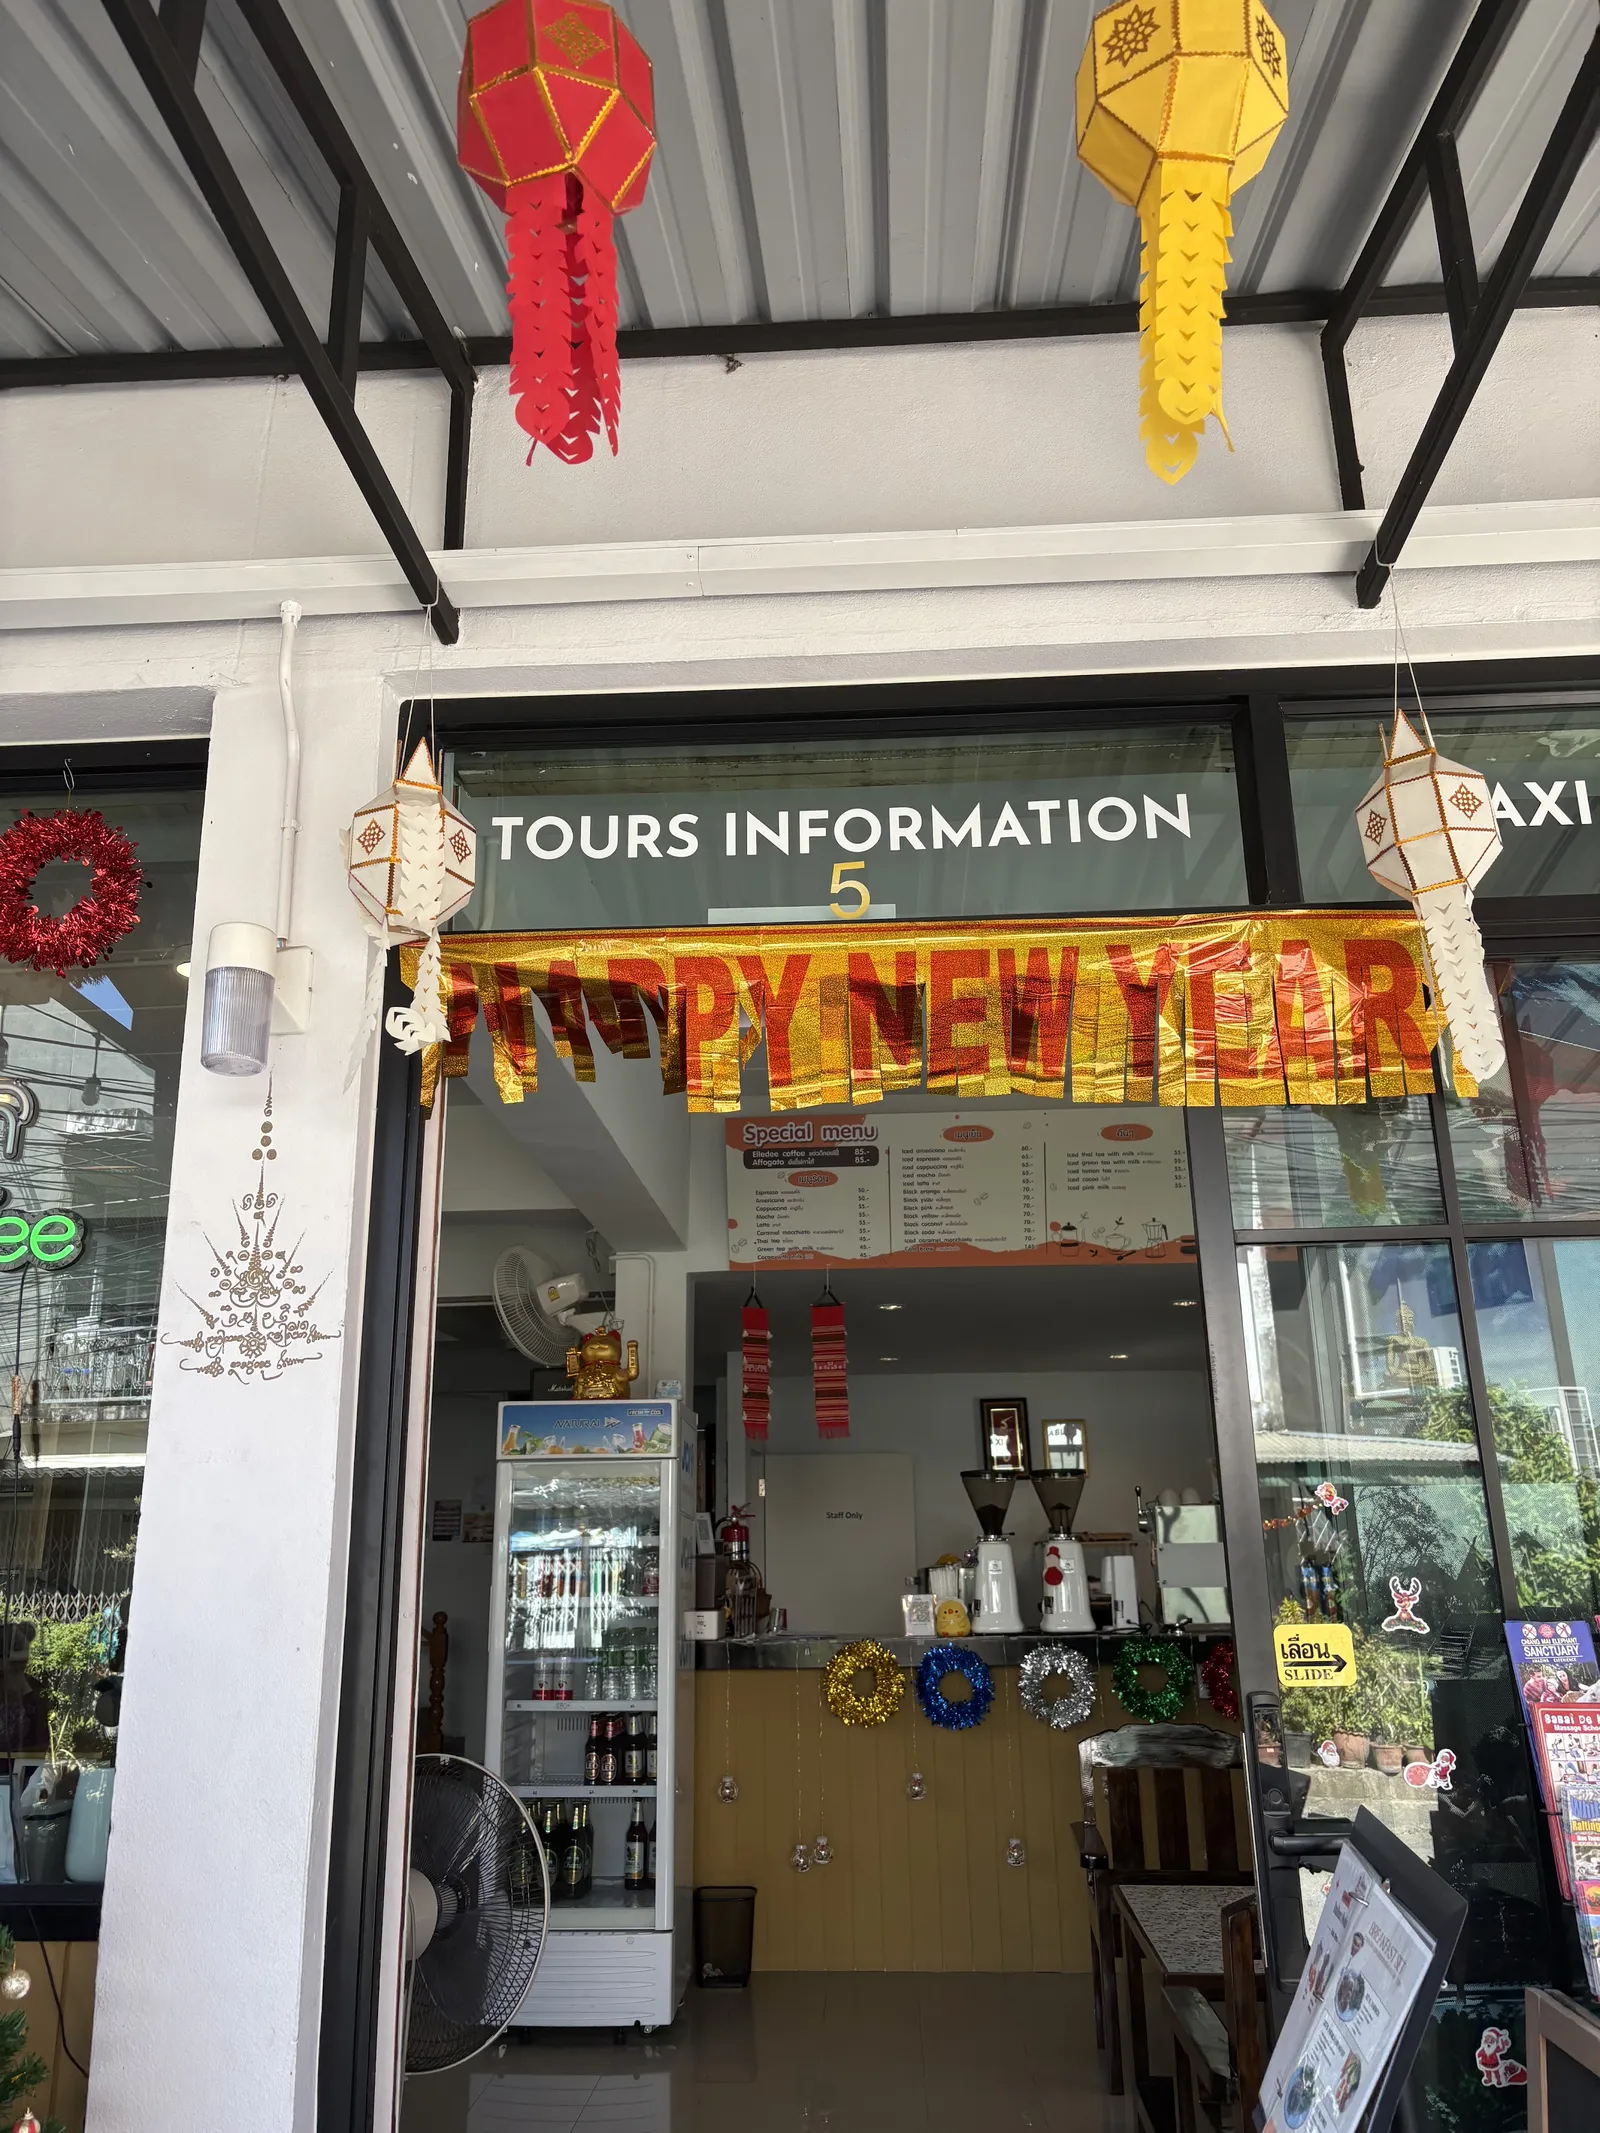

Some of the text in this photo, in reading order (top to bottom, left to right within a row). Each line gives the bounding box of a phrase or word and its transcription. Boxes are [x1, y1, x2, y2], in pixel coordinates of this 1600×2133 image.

[1491, 780, 1592, 828] AXI
[492, 794, 1191, 860] TOURS INFORMATION
[829, 860, 871, 919] 5
[446, 938, 1434, 1090] HAPPY NEW YEAR
[744, 1122, 877, 1146] Special menu
[782, 1149, 806, 1157] coffee
[854, 1148, 870, 1156] 85.-
[752, 1158, 785, 1168] Affogato
[854, 1156, 870, 1164] 85.-
[755, 1205, 788, 1213] Cappuccino
[825, 1511, 863, 1520] Staff Only
[1281, 1634, 1330, 1659] เลื่อน
[1524, 1645, 1579, 1657] SANCTUARY
[1284, 1668, 1334, 1681] SLIDE
[1553, 1724, 1581, 1732] Massage
[585, 1762, 599, 1770] LEO
[601, 1764, 615, 1772] LEO
